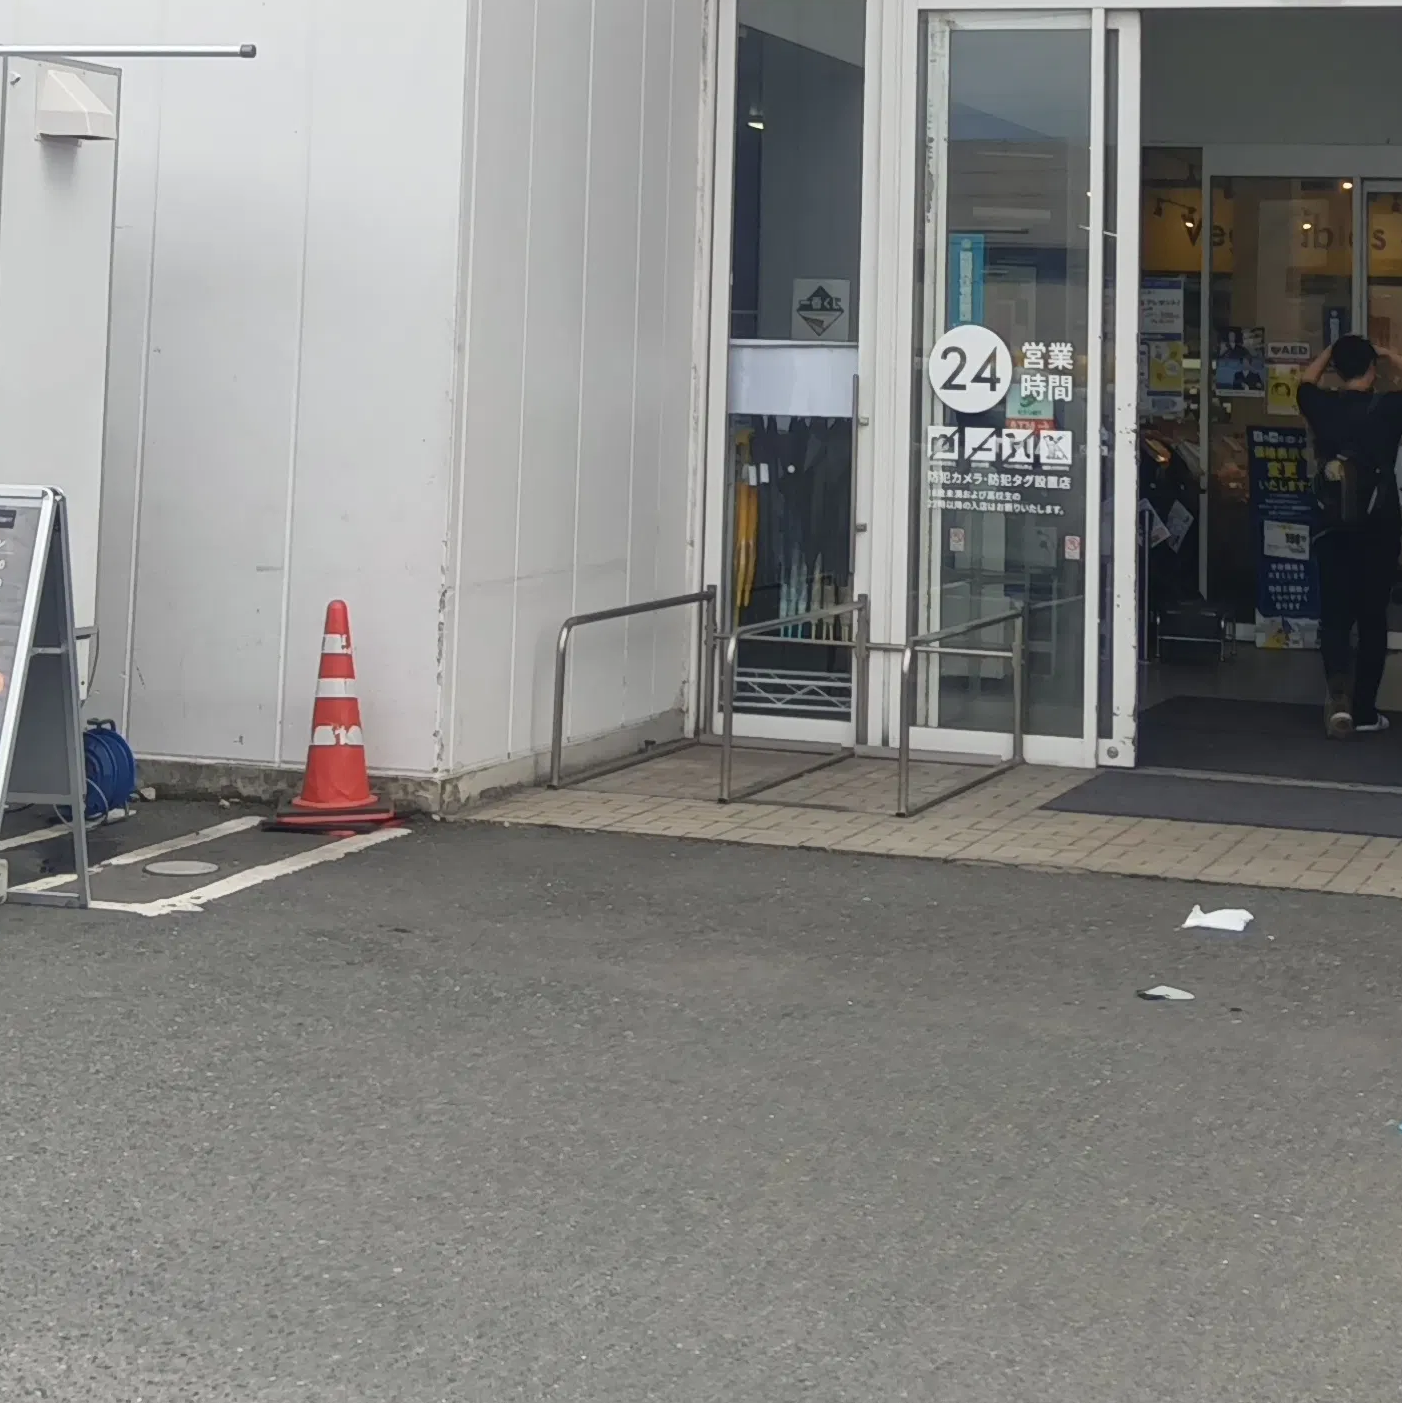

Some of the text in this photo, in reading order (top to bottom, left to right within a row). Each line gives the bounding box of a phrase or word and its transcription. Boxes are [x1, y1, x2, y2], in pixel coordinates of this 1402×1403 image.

[939, 346, 1002, 392] 24
[1021, 341, 1074, 371] 営業
[1020, 374, 1073, 402] 時間
